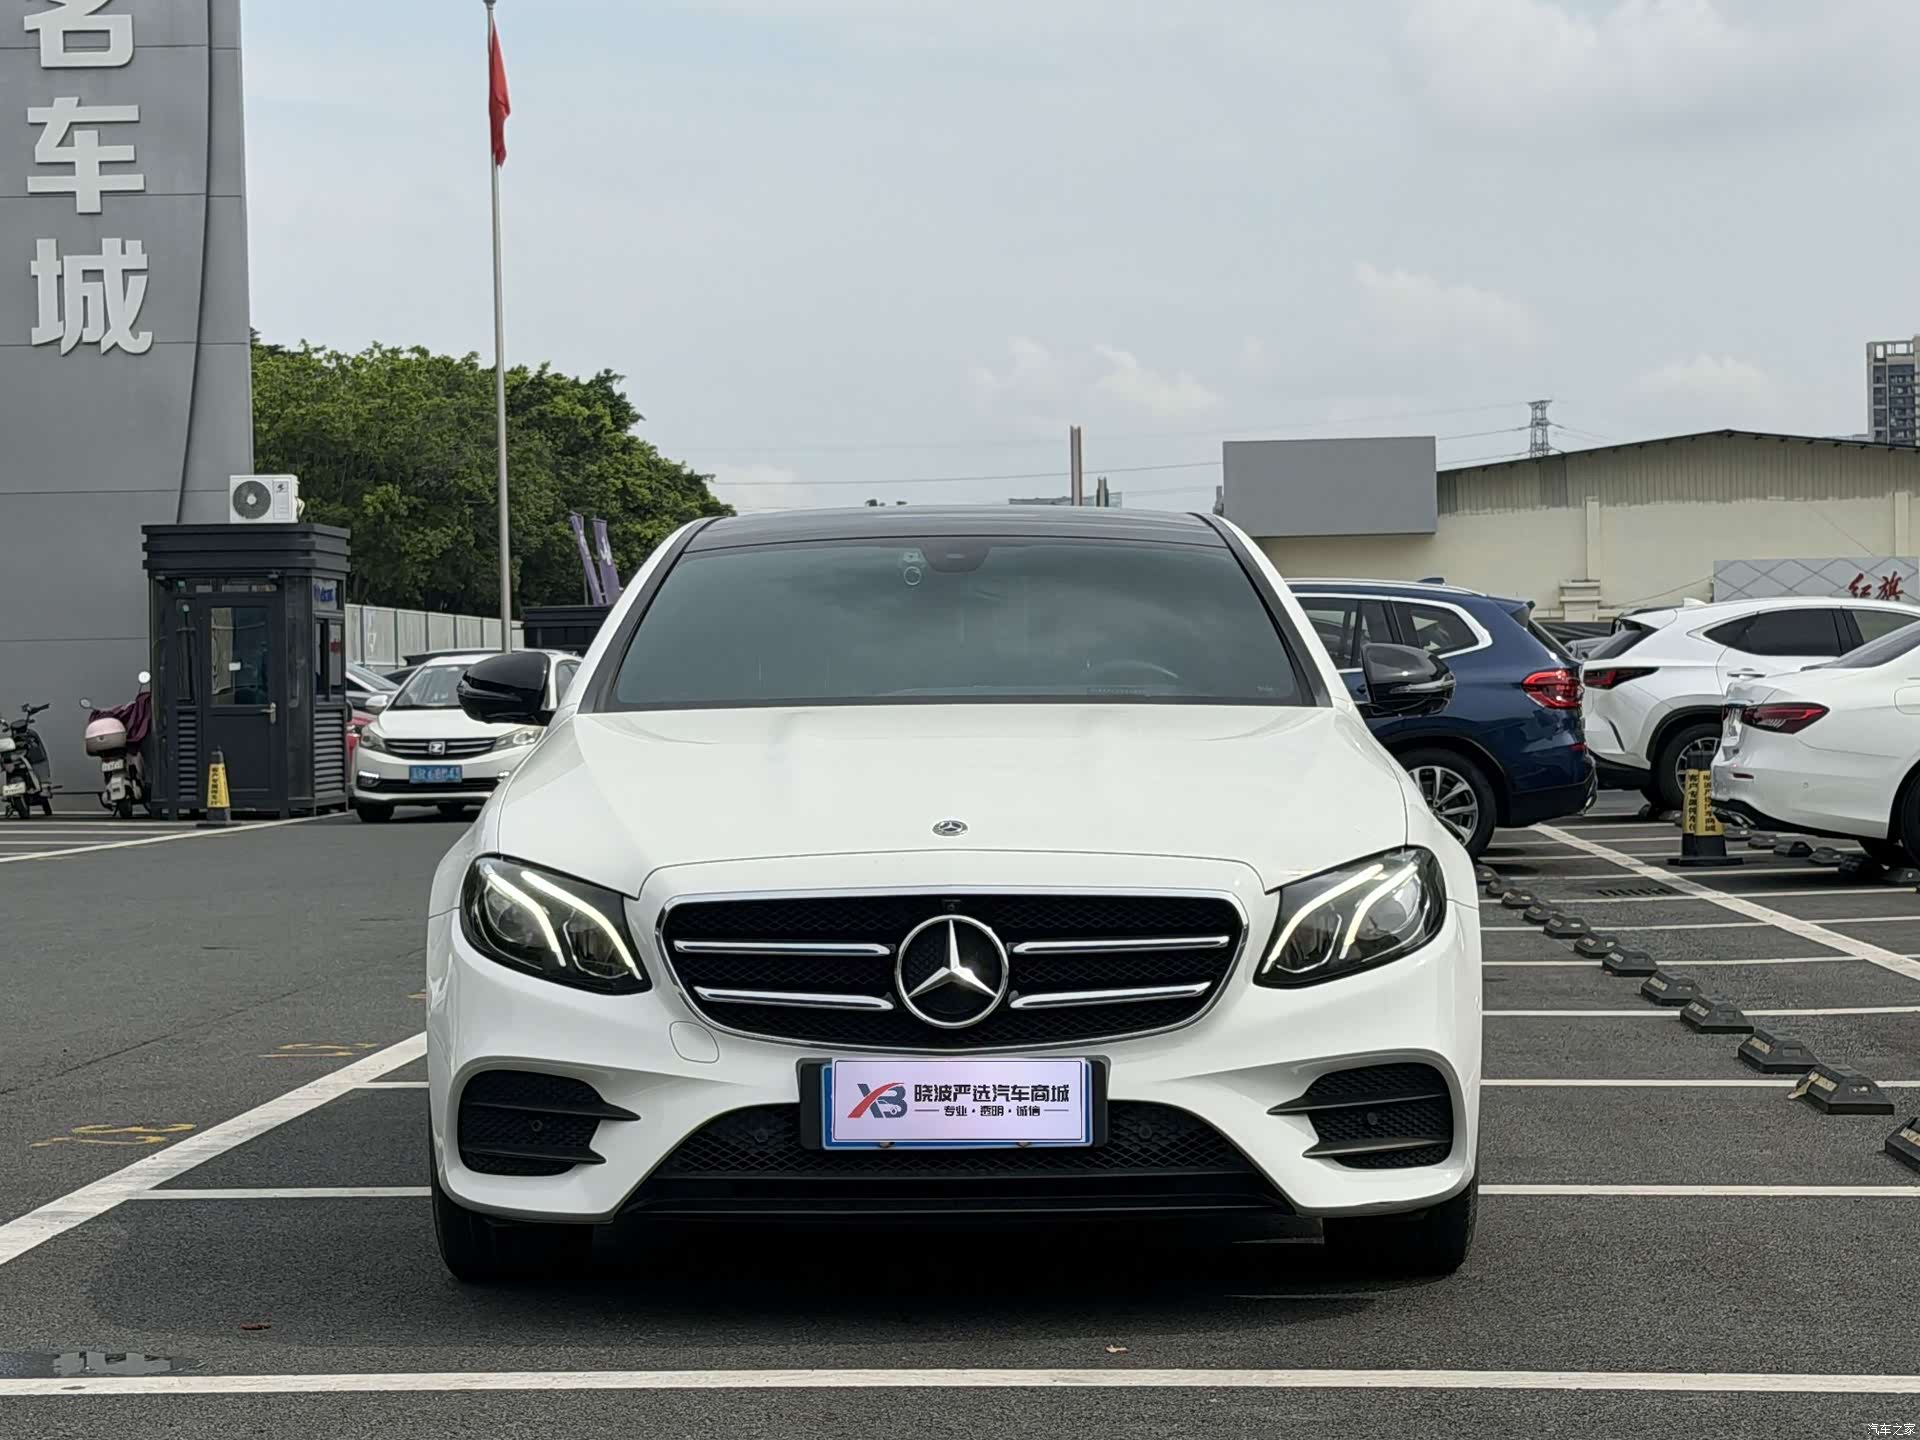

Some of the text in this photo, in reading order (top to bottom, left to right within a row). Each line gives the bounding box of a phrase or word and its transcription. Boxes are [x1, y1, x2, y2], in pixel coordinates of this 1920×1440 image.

[1847, 570, 1904, 601] 红旗
[913, 1084, 1070, 1102] 晓波严选汽车商城
